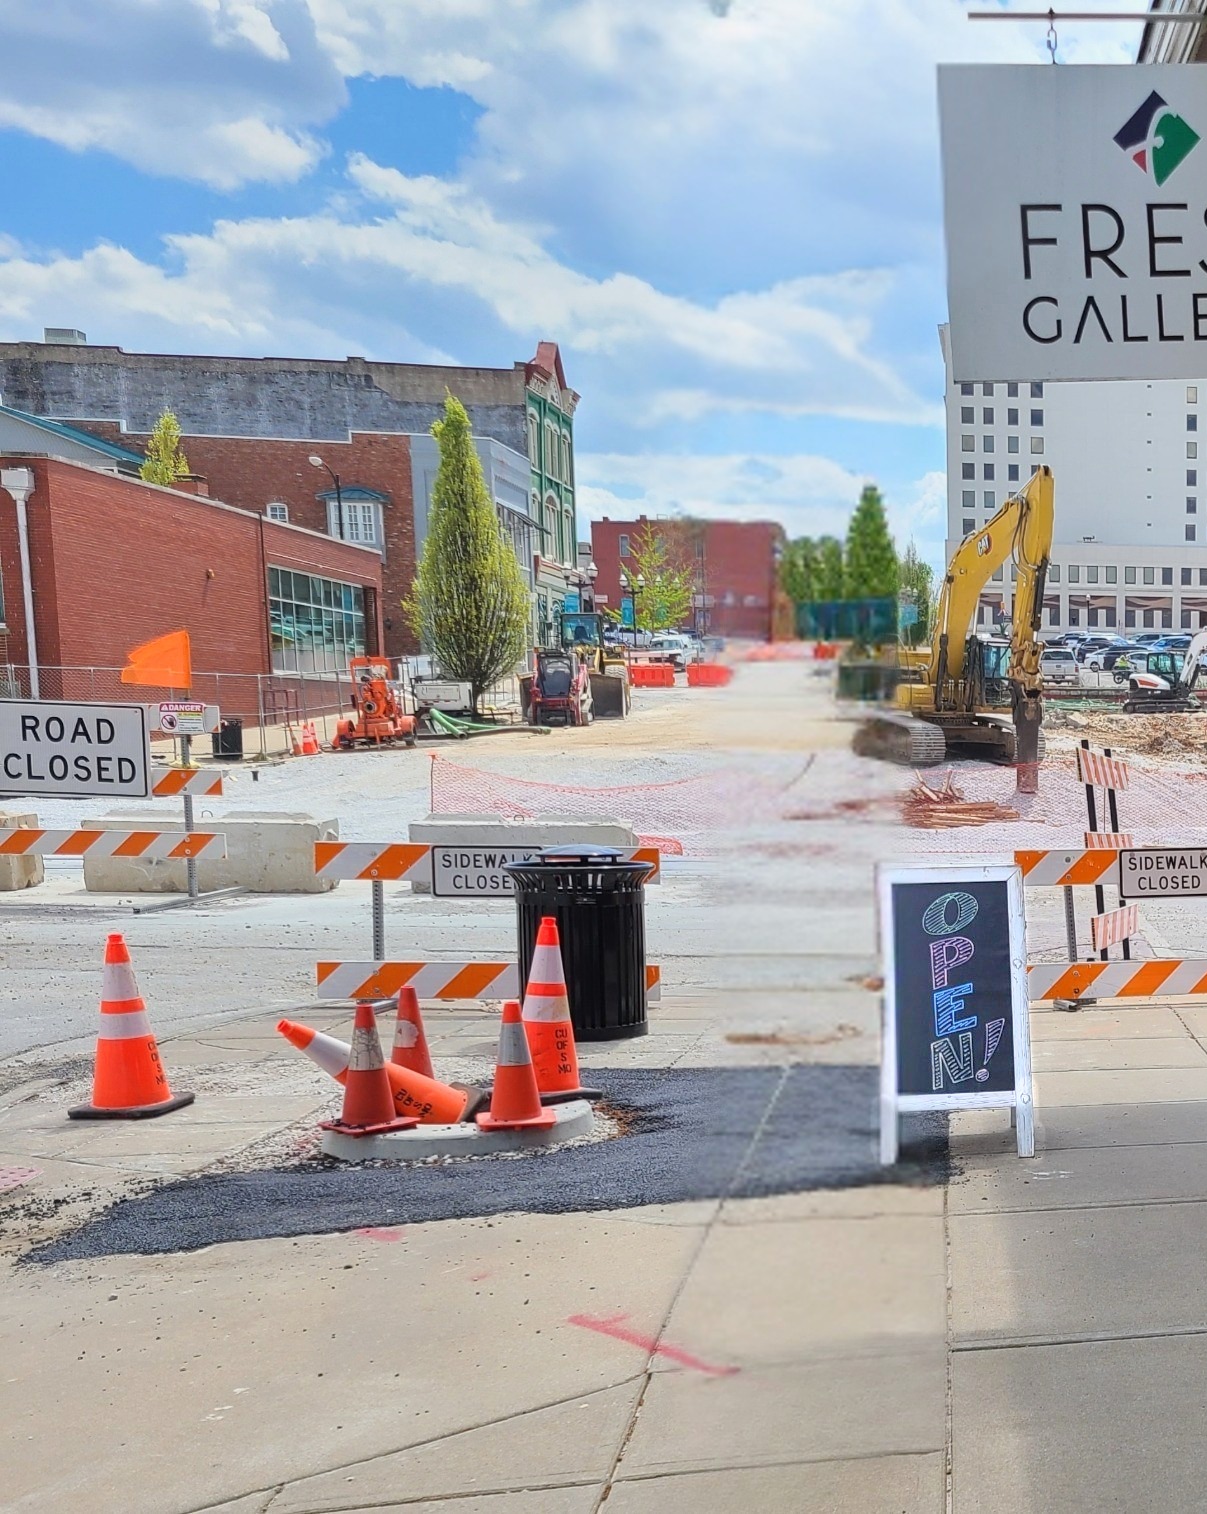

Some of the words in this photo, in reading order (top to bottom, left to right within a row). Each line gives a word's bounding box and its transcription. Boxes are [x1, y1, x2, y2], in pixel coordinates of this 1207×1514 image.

[977, 533, 990, 557] CAT
[168, 704, 202, 712] DANGER
[20, 715, 116, 745] ROAD
[3, 752, 137, 784] CLOSED
[452, 875, 516, 890] CLOSE
[1138, 875, 1201, 891] CLOSED
[922, 891, 1005, 1091] OPEN!
[556, 1040, 568, 1050] OF
[560, 1052, 567, 1062] S
